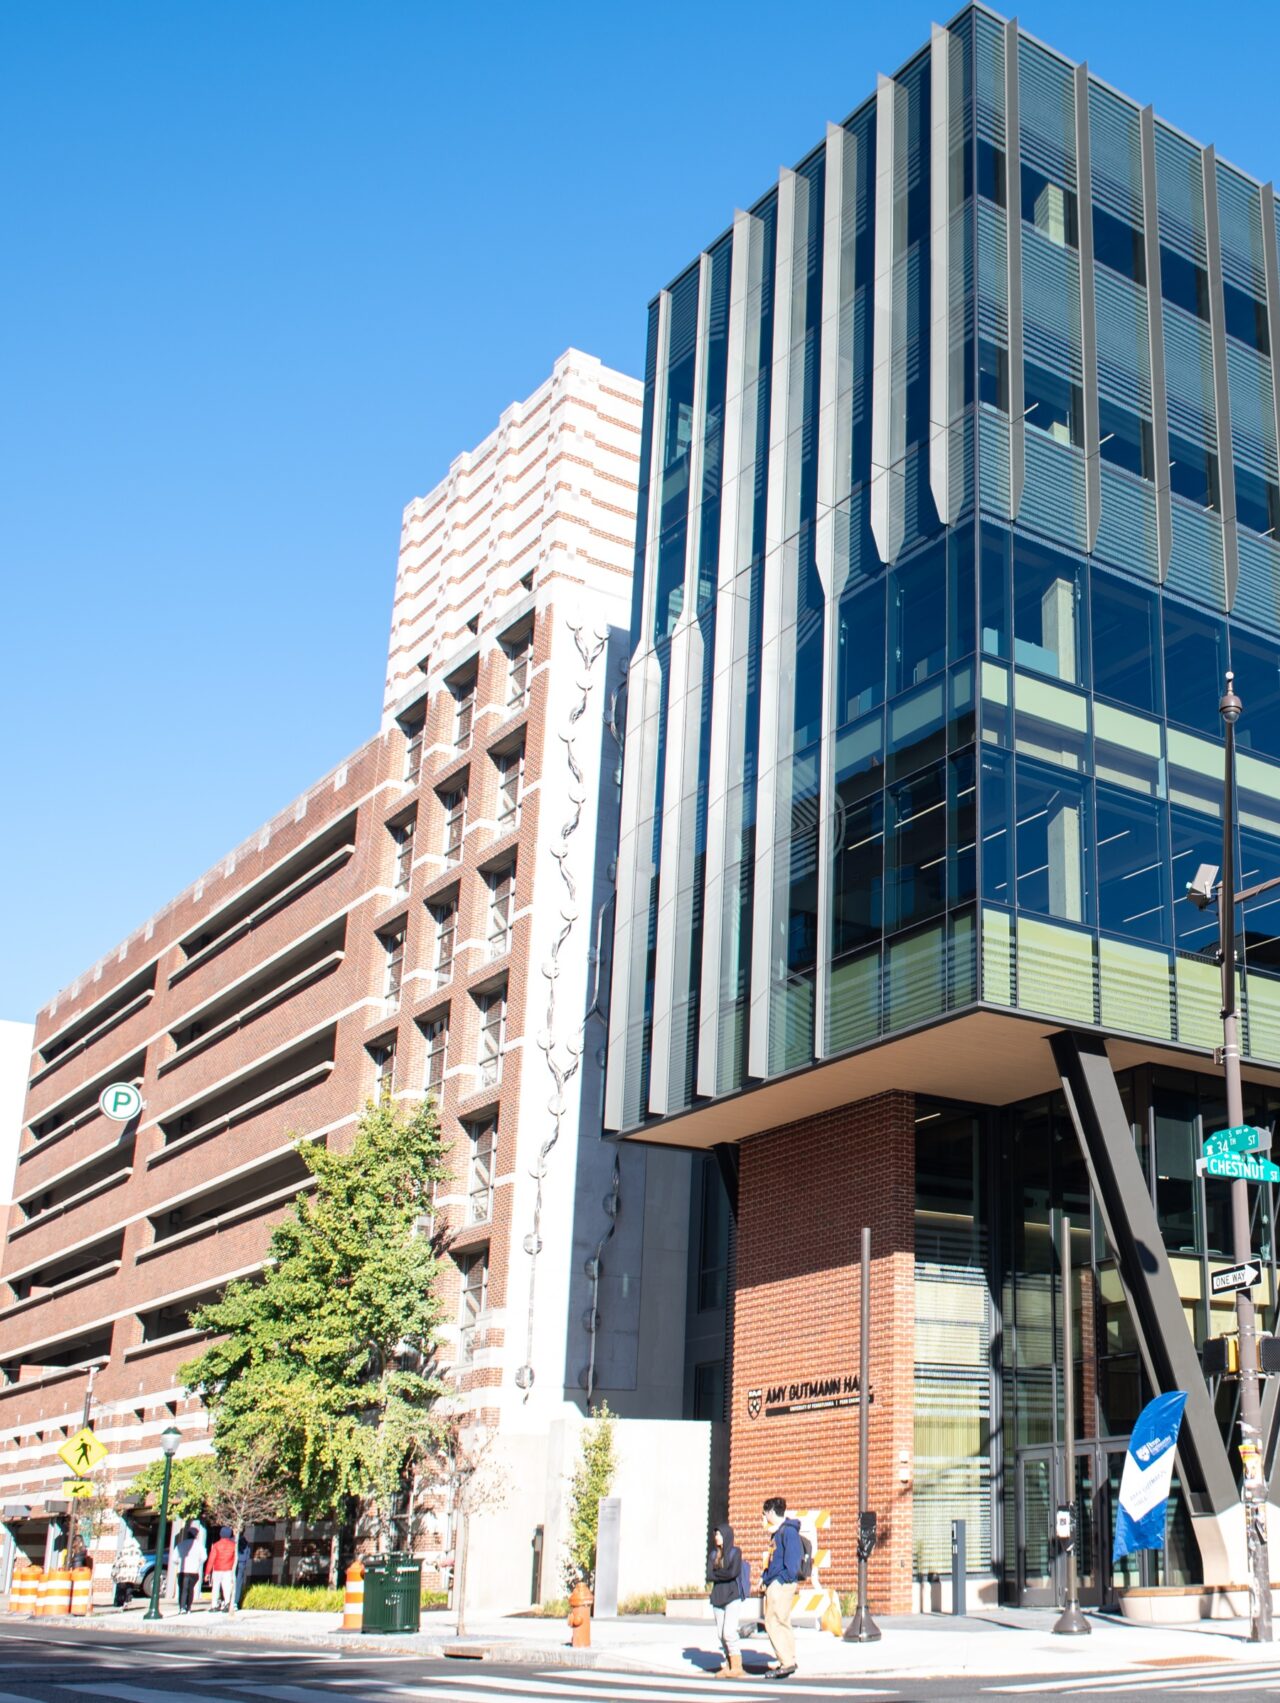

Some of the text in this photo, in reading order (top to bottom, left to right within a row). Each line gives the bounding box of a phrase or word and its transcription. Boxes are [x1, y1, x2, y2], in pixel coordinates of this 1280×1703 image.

[112, 1091, 132, 1112] P
[1248, 1134, 1255, 1146] ST
[1210, 1158, 1264, 1180] CHESTNUT
[1215, 1271, 1245, 1287] ONE WAY
[765, 1386, 787, 1404] AMY
[789, 1377, 841, 1401] GUTMANN
